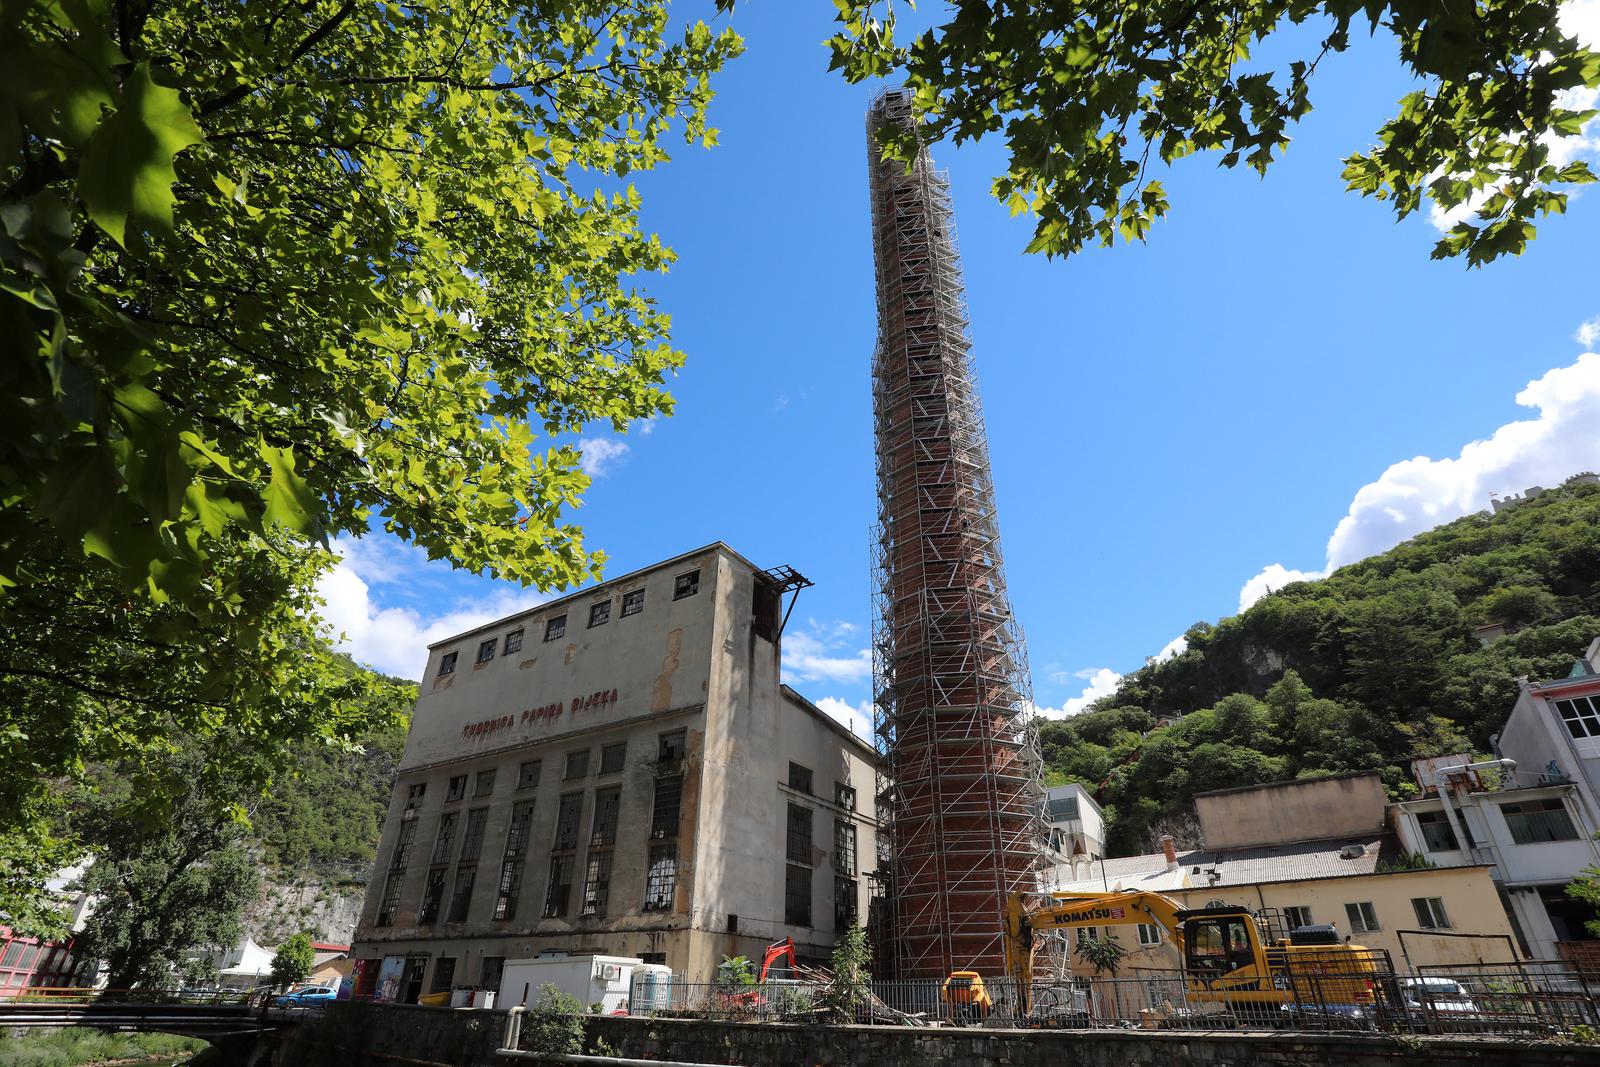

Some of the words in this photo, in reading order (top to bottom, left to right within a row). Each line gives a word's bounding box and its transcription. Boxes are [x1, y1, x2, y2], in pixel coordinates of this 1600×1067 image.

[463, 714, 514, 737] TVORNICA
[521, 702, 563, 723] PAPIRA
[571, 688, 617, 712] RIJEKA
[1055, 908, 1110, 924] KOMATSU
